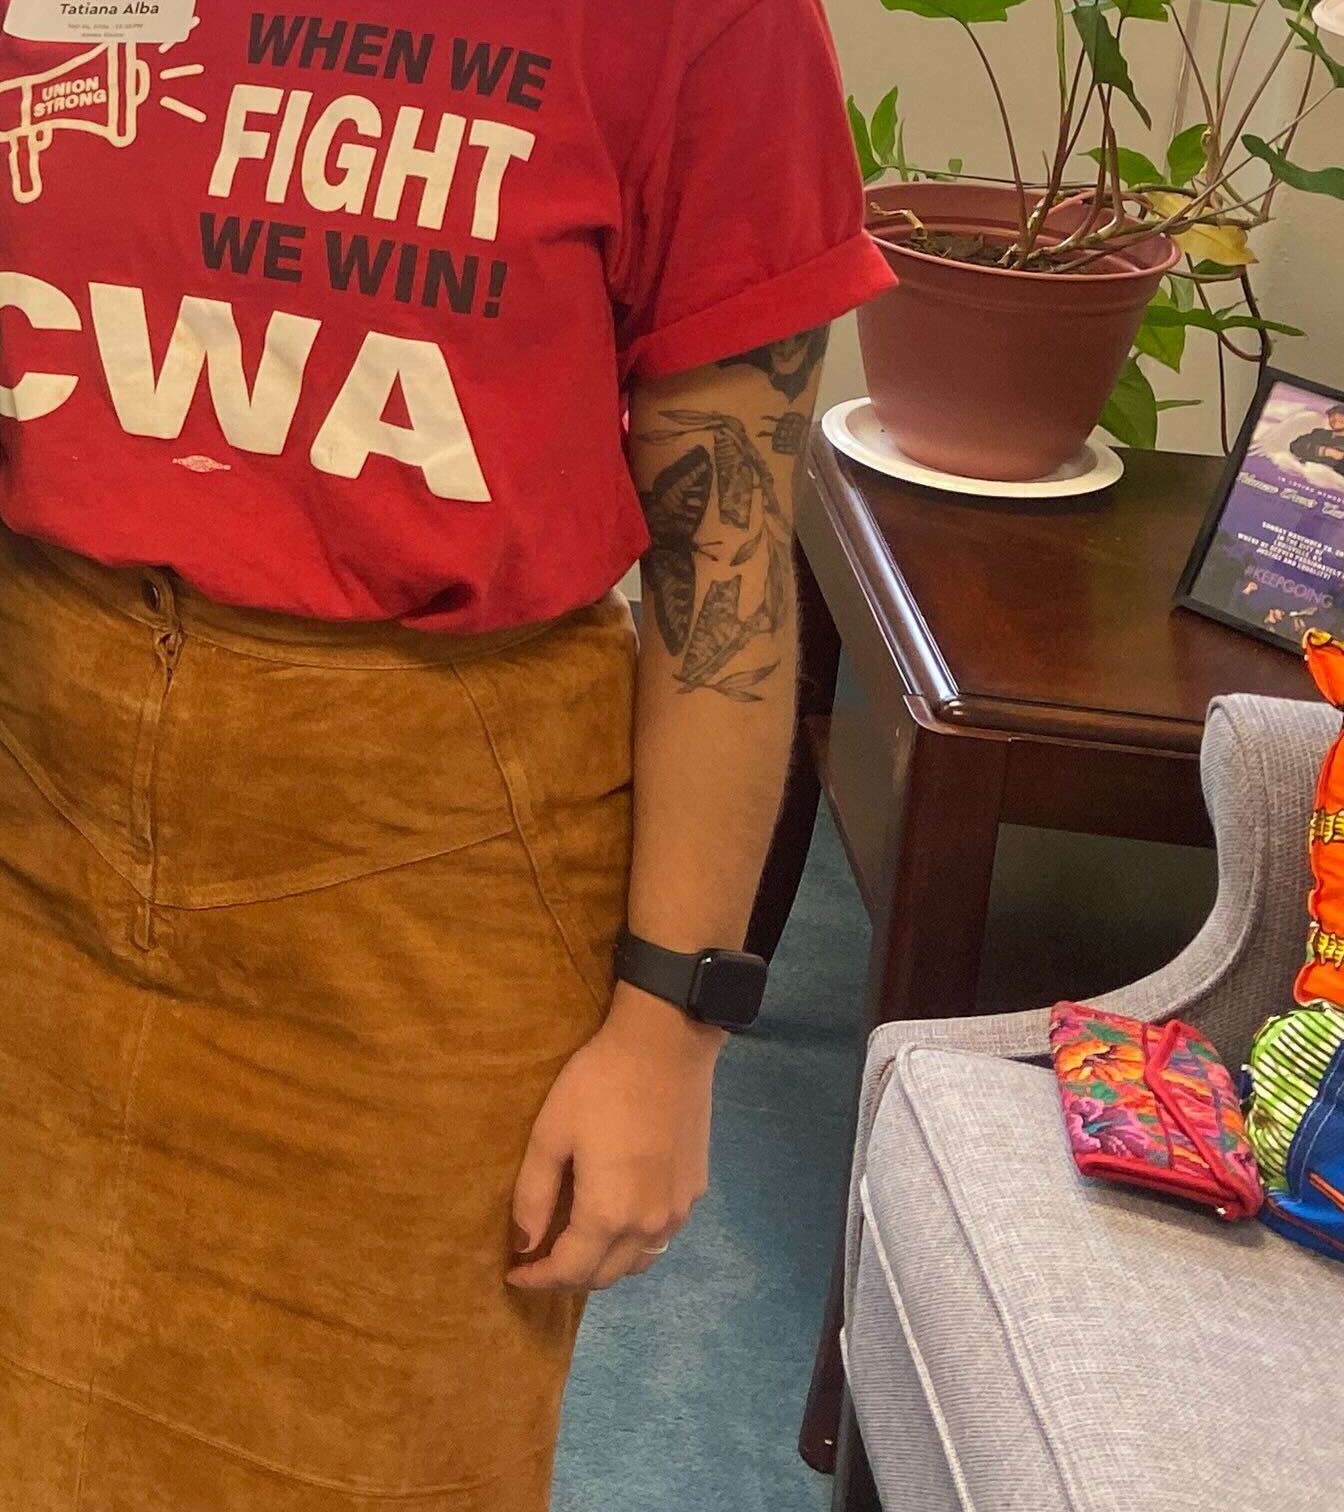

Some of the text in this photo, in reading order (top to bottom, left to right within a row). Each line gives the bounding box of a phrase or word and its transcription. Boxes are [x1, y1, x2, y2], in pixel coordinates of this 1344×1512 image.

[60, 2, 160, 15] Tatiana Alba
[42, 76, 99, 101] UNION
[247, 12, 552, 111] WHEN WE
[33, 88, 107, 117] STRONG
[208, 83, 536, 241] FIGHT
[199, 211, 508, 319] WE WIN!
